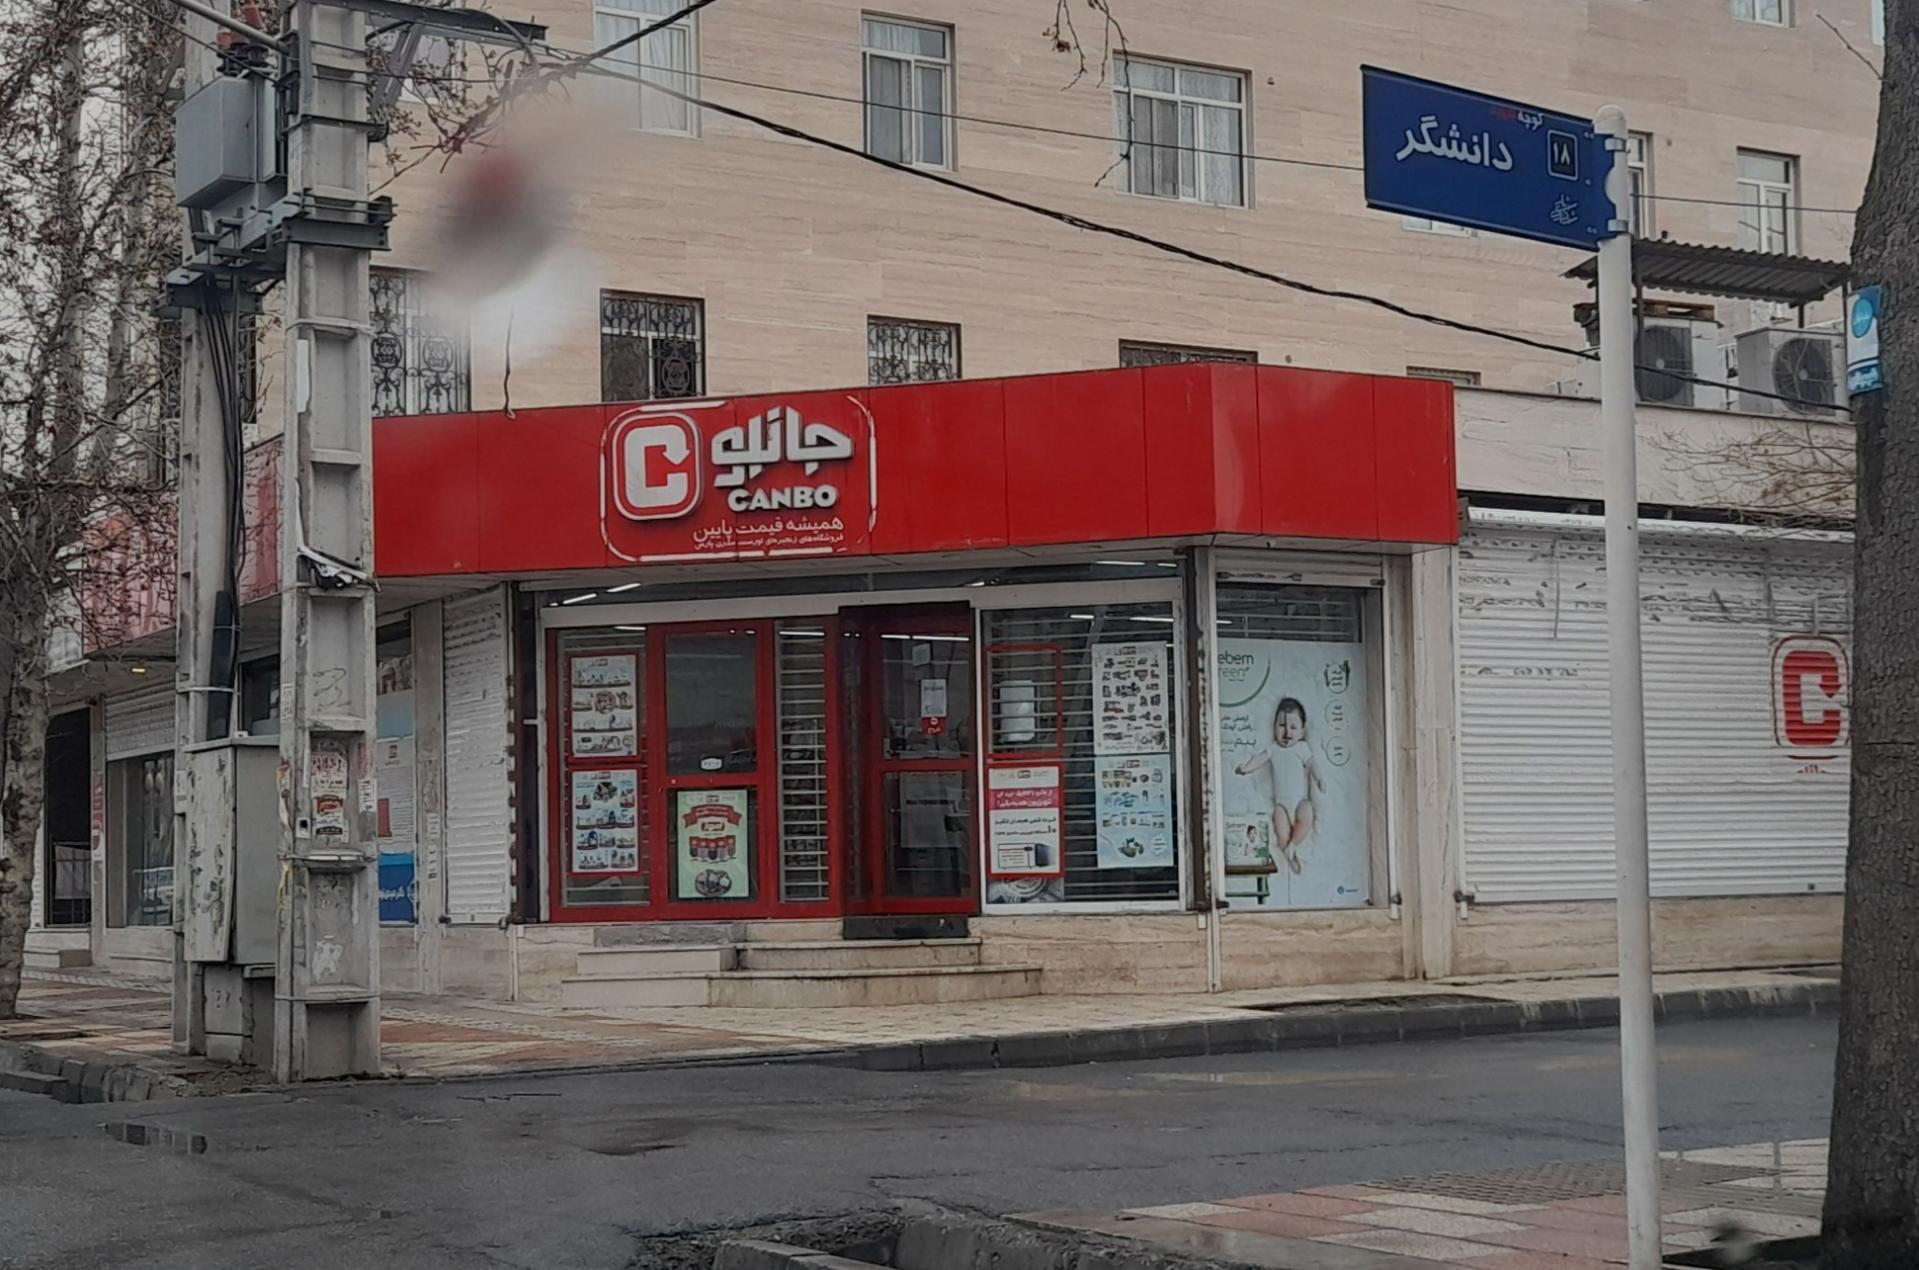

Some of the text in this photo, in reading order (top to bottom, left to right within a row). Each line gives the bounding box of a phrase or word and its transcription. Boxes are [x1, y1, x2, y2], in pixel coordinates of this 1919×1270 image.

[1396, 115, 1513, 171] دانشگر
[1553, 142, 1571, 166] ۱۸
[727, 484, 838, 512] CANBO
[693, 519, 733, 542] پایین
[735, 517, 783, 535] قیمت
[786, 515, 844, 534] همیشه
[1218, 650, 1254, 665] ebem
[1218, 667, 1247, 678] reen
